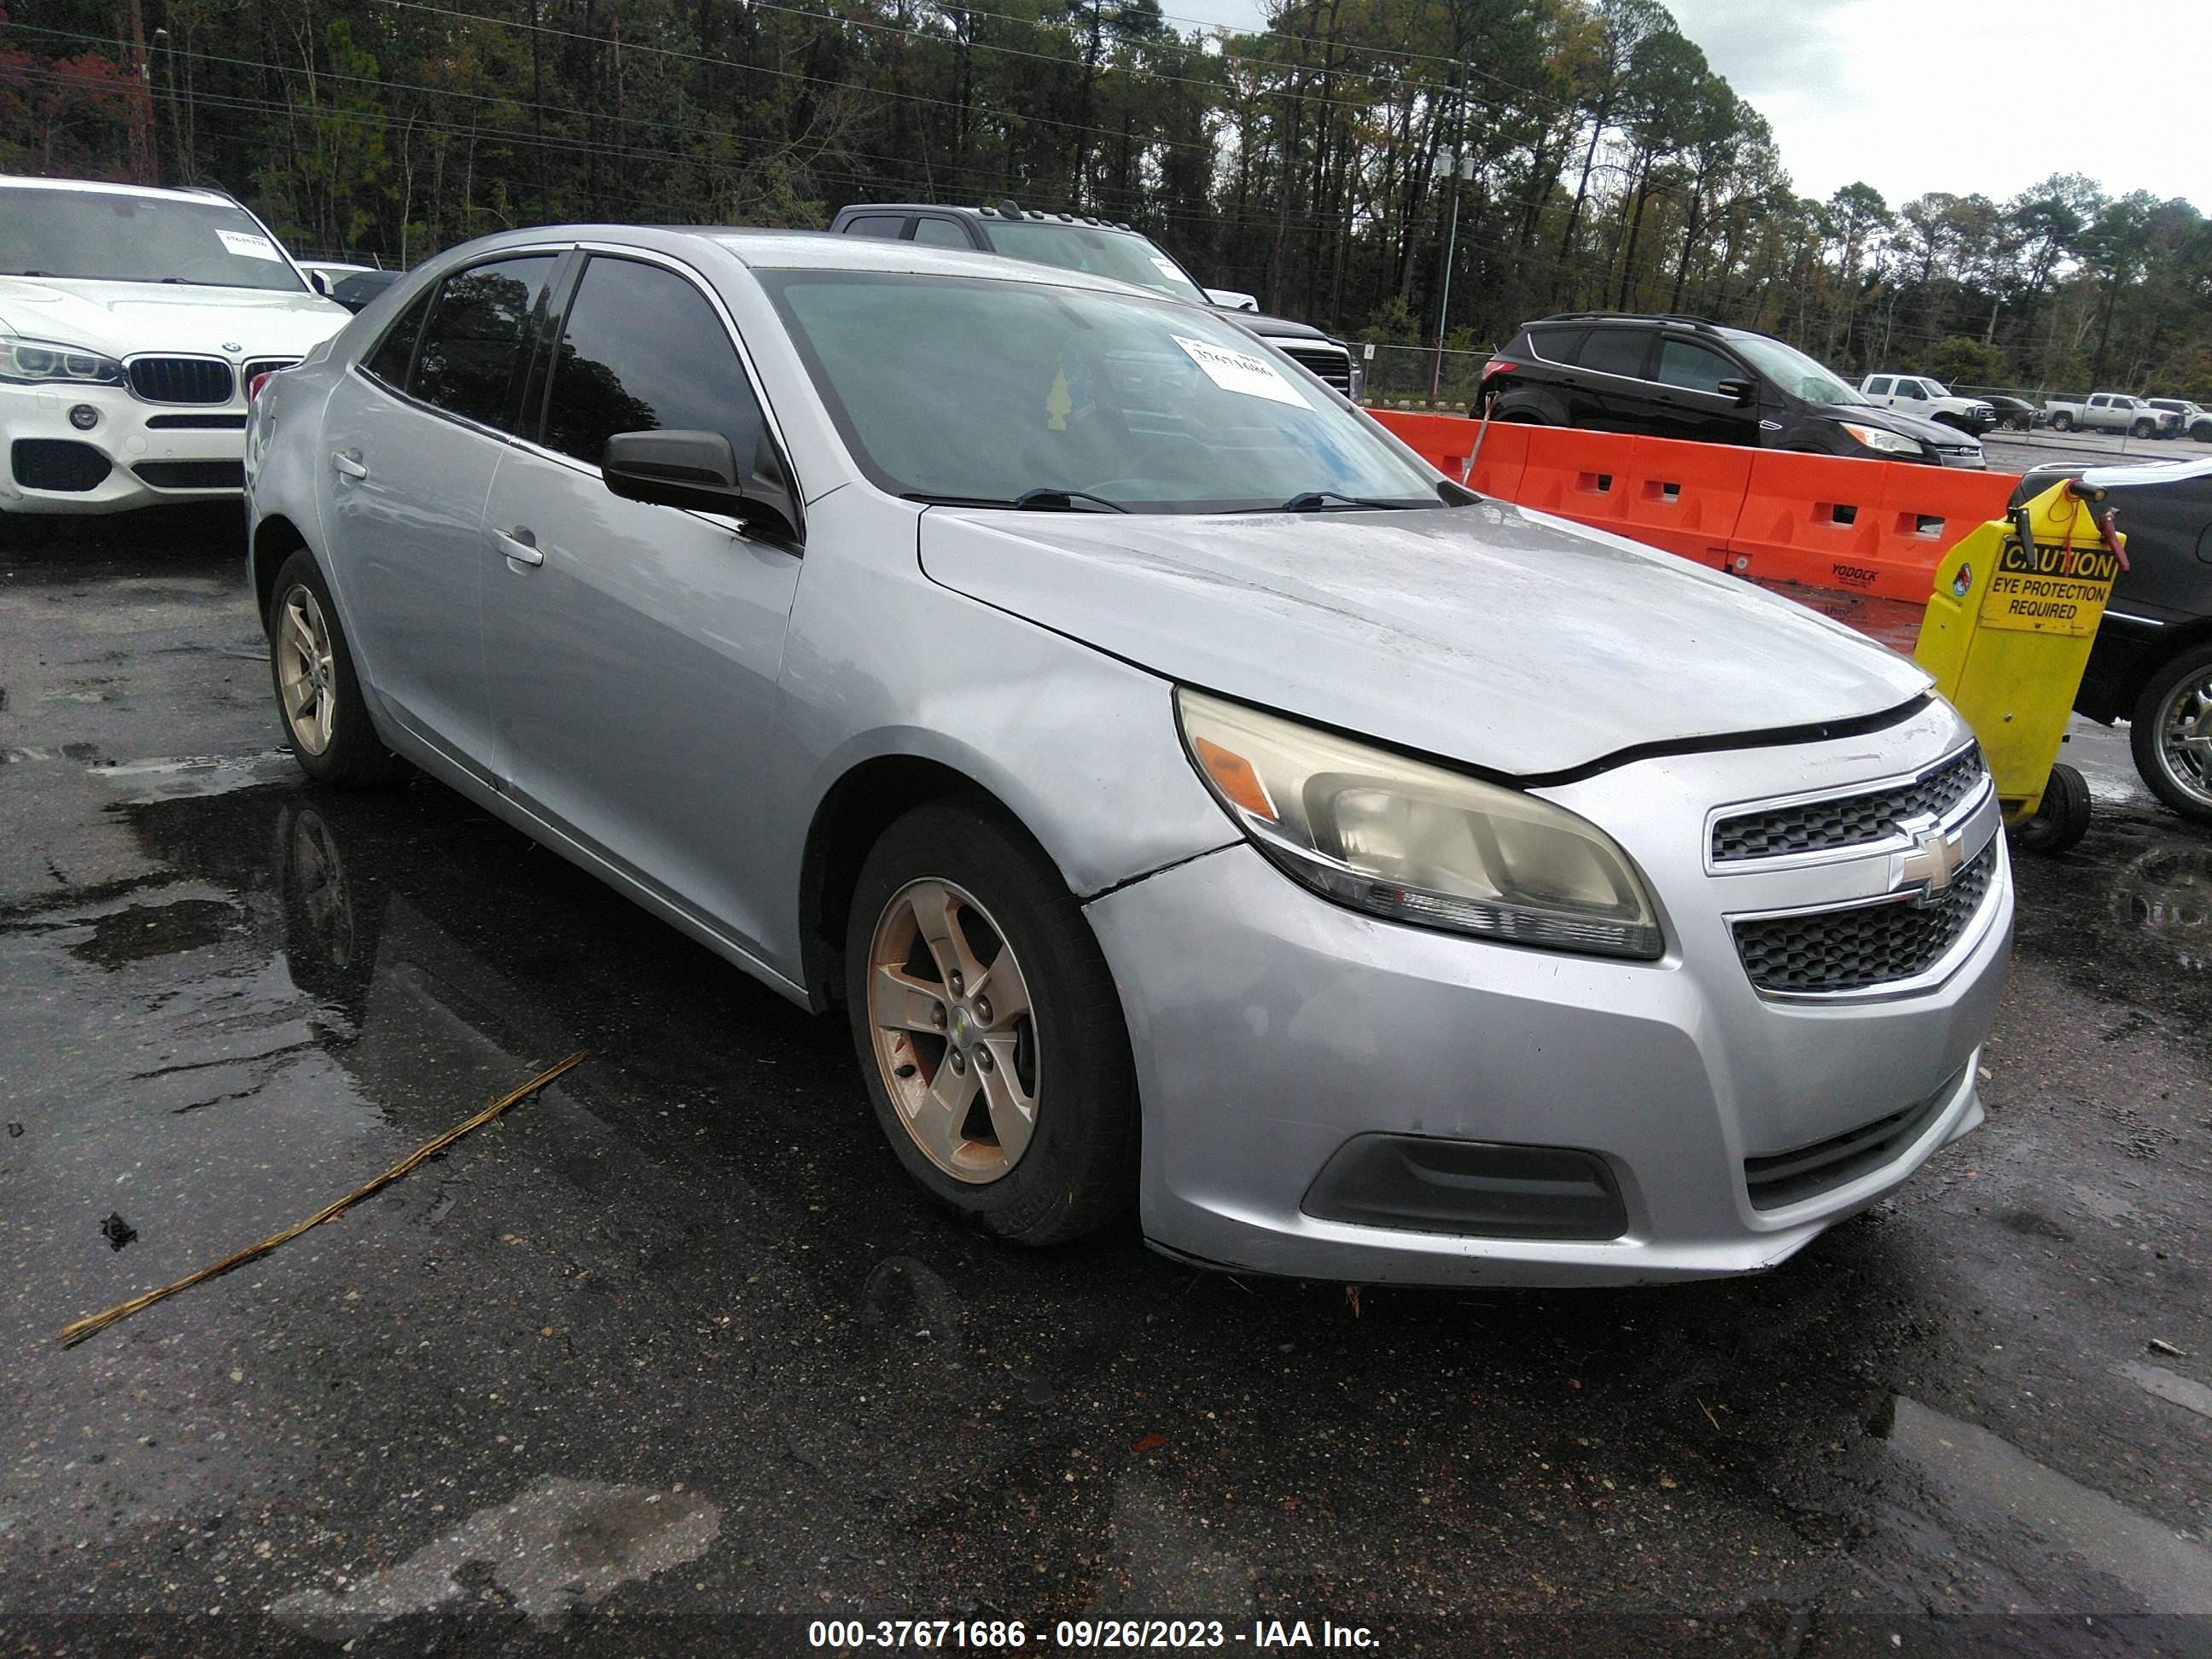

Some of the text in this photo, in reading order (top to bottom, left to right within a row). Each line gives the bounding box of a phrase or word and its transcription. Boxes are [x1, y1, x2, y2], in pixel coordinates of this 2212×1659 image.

[1193, 349, 1273, 377] 37671686
[1831, 564, 1878, 581] YODOCK
[1993, 577, 2106, 602] EYE PROTECTION
[2008, 599, 2077, 620] REQUIRED
